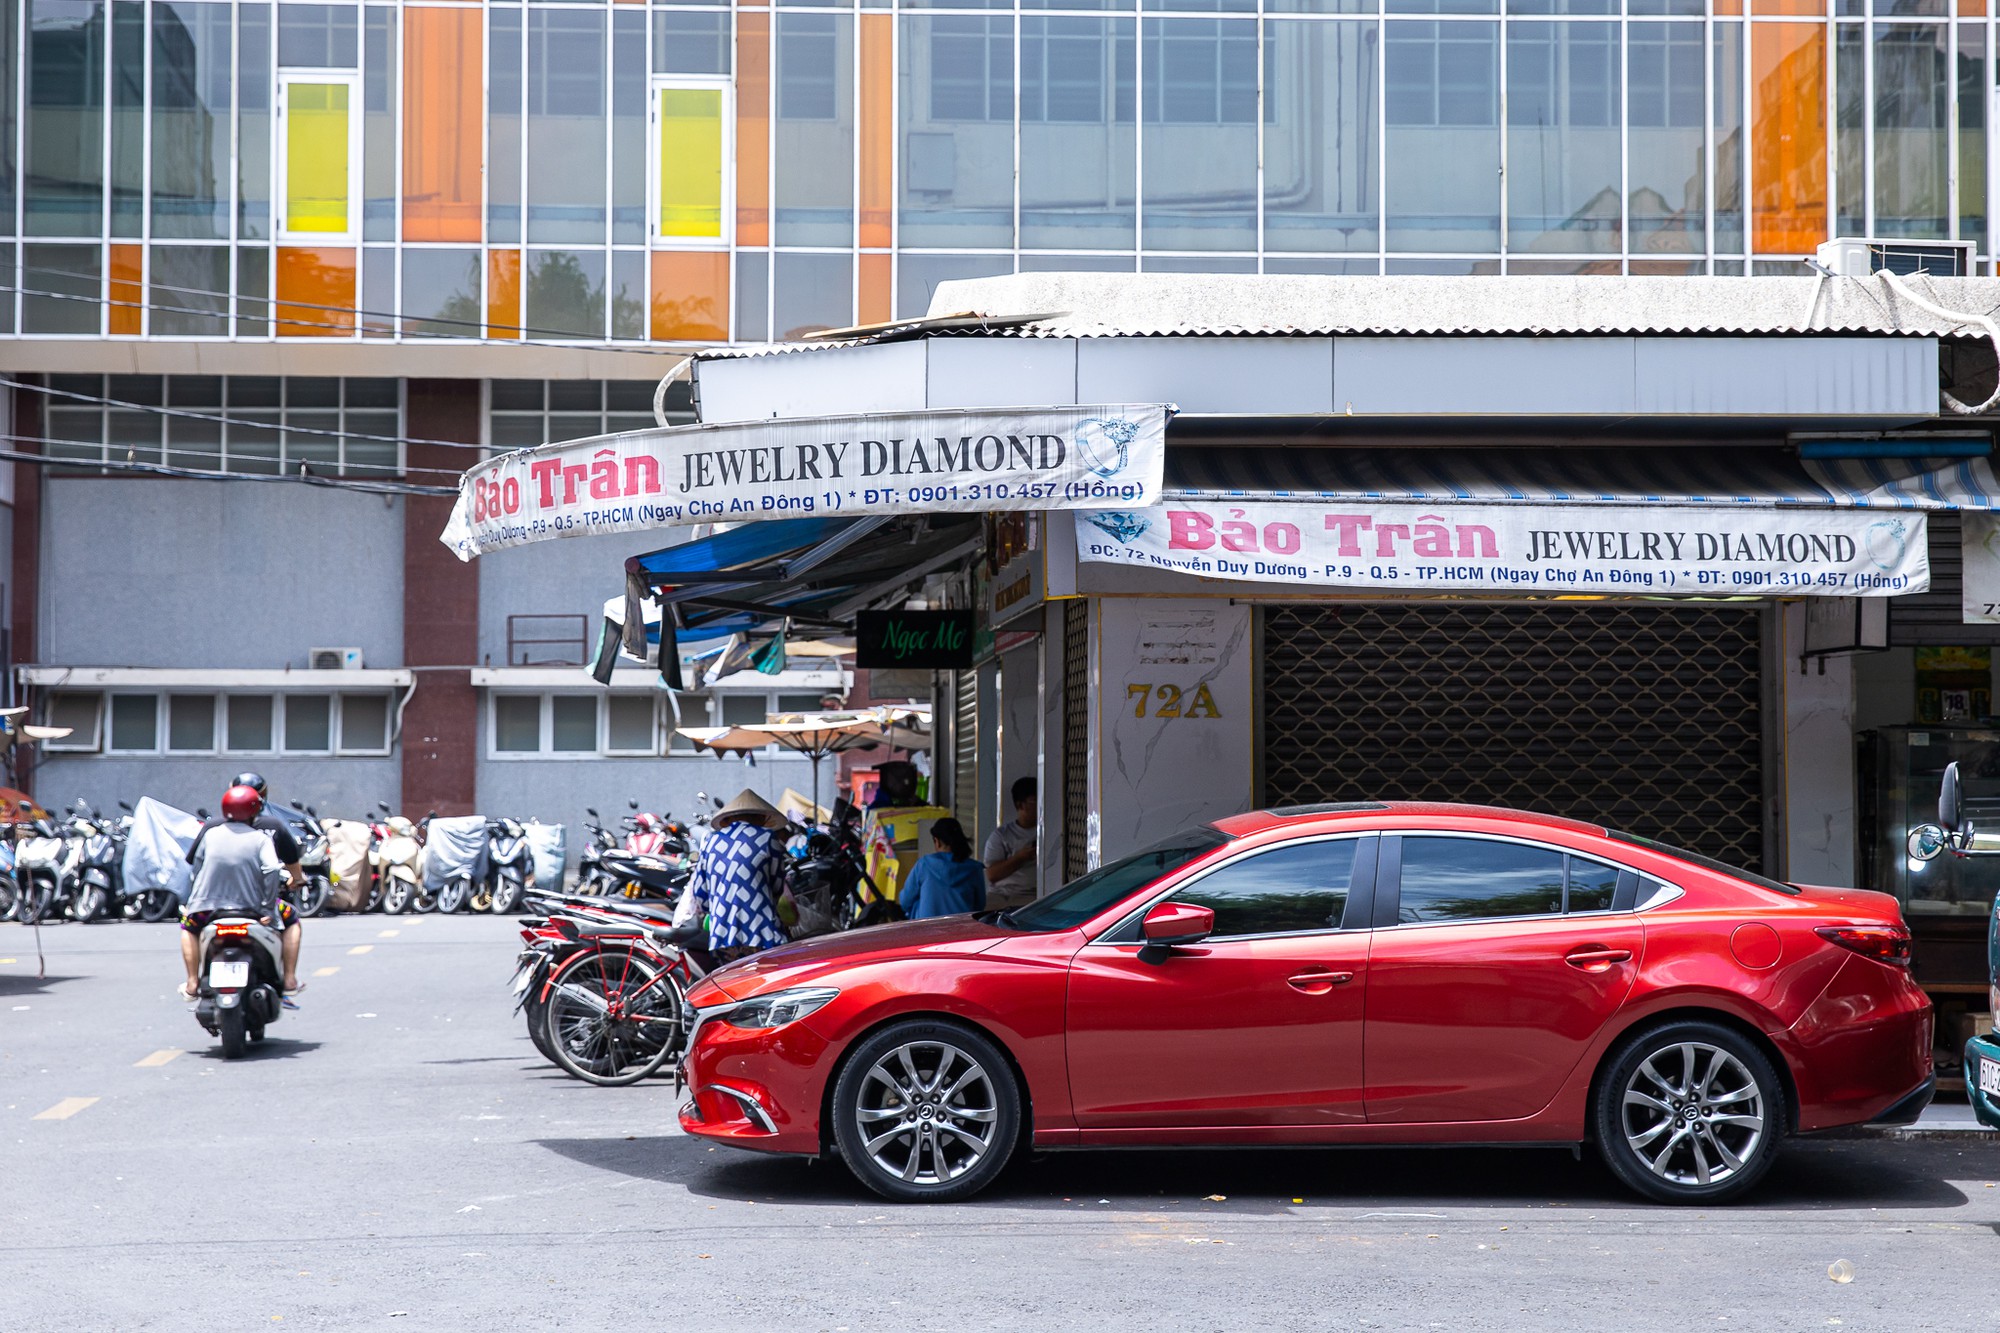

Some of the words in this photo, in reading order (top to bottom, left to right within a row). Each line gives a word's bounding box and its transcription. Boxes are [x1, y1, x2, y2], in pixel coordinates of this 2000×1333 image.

[474, 468, 519, 523] Bảo
[531, 449, 661, 508] Trân
[680, 442, 849, 493] JEWELRY
[861, 435, 1065, 476] DIAMOND
[532, 519, 546, 534] P.9
[554, 515, 573, 534] Q.5
[583, 506, 634, 527] TP.HCM
[638, 504, 683, 523] (Ngay
[688, 500, 724, 517] Chợ
[729, 497, 755, 513] An
[761, 494, 815, 512] Đông
[822, 491, 842, 511] 1)
[863, 488, 900, 505] ĐT:
[908, 483, 1057, 503] 0901.310.457
[1064, 479, 1144, 502] (Hồng)
[1167, 508, 1300, 555] Bảo
[1325, 514, 1499, 558] Trân
[1526, 531, 1685, 561] JEWELRY
[1695, 532, 1855, 562] DIAMOND
[1089, 544, 1119, 558] ĐC:
[1125, 547, 1145, 560] 72
[1217, 559, 1249, 576] Duy
[1325, 564, 1352, 578] P.9
[1370, 565, 1398, 580] Q.5
[1415, 566, 1484, 580] TP.HCM
[1490, 566, 1539, 584] (Ngay
[1545, 568, 1577, 585] Chợ
[1582, 568, 1604, 583] An
[1608, 569, 1653, 587] Đông
[1659, 570, 1676, 587] 1)
[1697, 570, 1726, 584] ĐT:
[1732, 570, 1848, 587] 0901.310.457
[1854, 572, 1908, 590] (Hồng)
[1983, 603, 2000, 615] 7
[1127, 682, 1222, 719] 72A
[1947, 694, 1964, 710] 18
